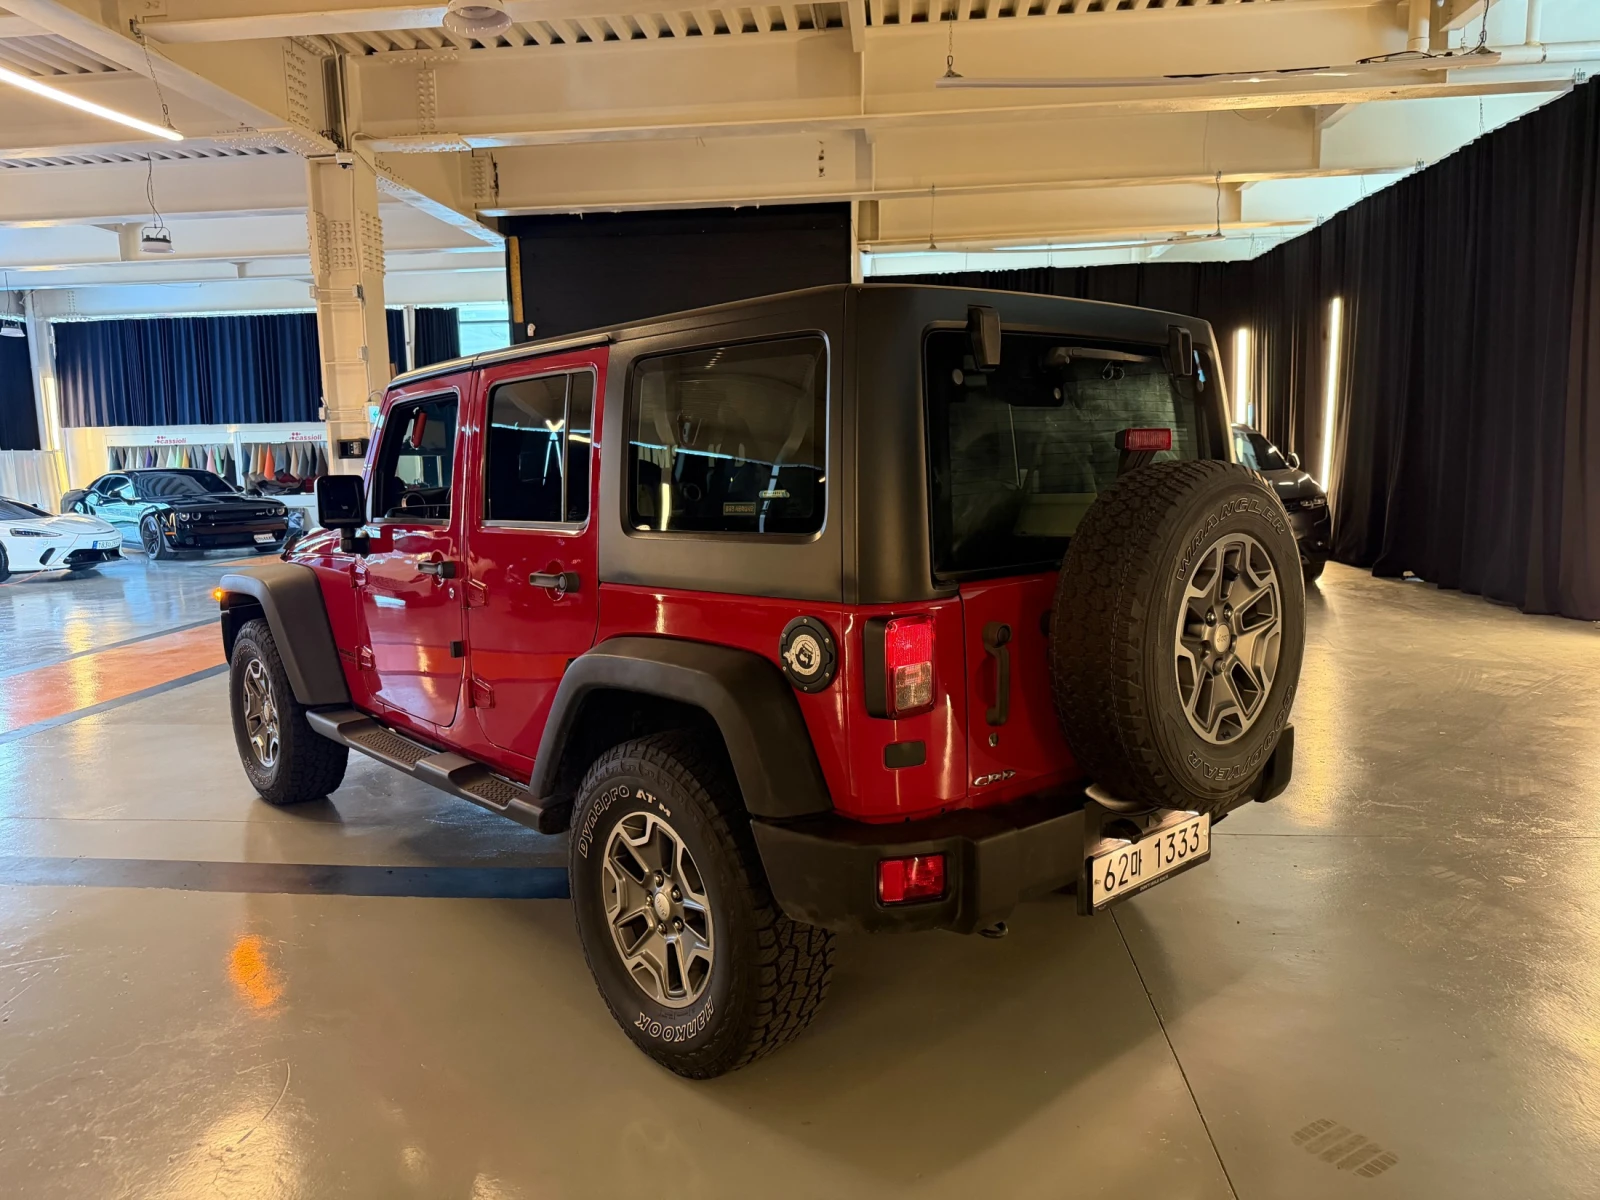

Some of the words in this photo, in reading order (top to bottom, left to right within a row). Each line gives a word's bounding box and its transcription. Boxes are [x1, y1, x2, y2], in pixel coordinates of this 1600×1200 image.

[294, 433, 322, 441] cassioli
[1176, 497, 1286, 581] WRANGLER
[1187, 685, 1294, 781] GOODYEAR
[973, 770, 1017, 786] CRD
[578, 784, 630, 859] Dynapro
[1104, 848, 1143, 892] 62마
[1154, 822, 1200, 869] 1333
